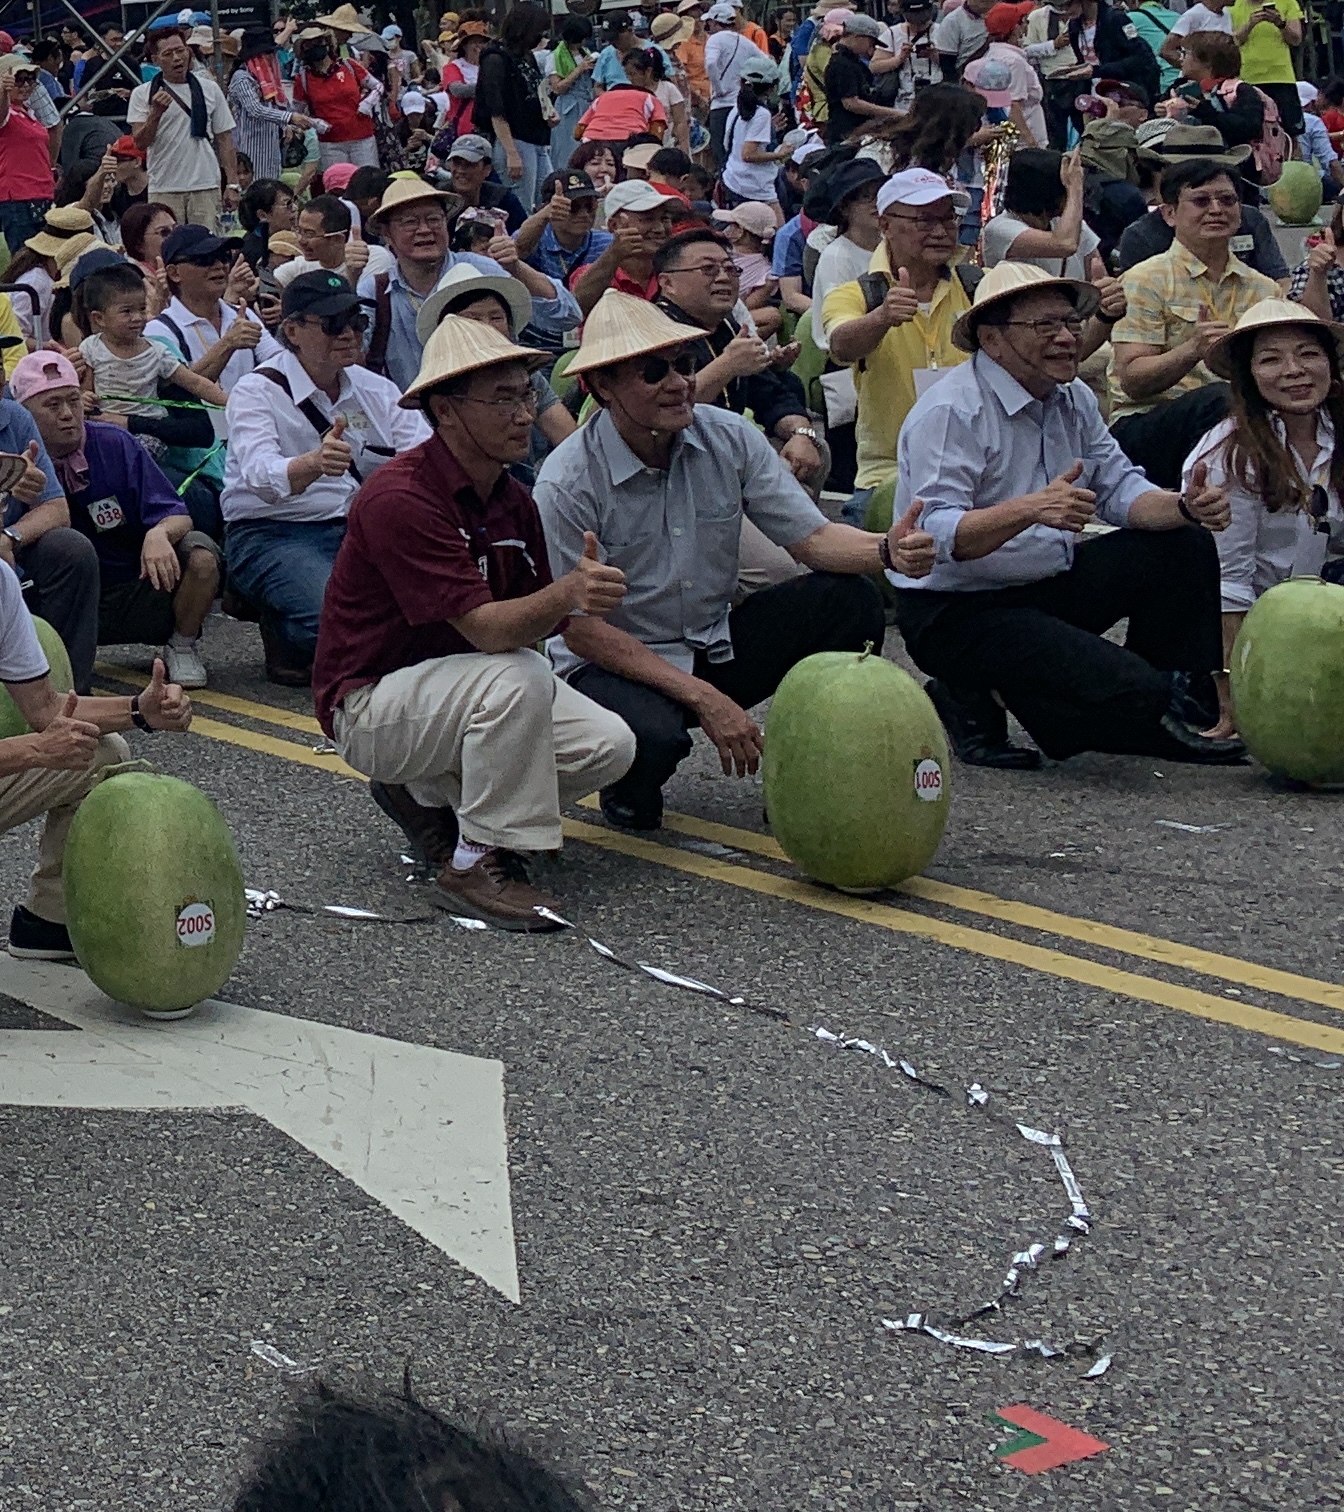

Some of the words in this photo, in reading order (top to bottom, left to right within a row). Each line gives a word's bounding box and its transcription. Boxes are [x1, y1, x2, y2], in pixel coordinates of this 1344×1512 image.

[96, 508, 122, 525] 038
[916, 770, 941, 789] S001
[177, 913, 213, 935] S002
